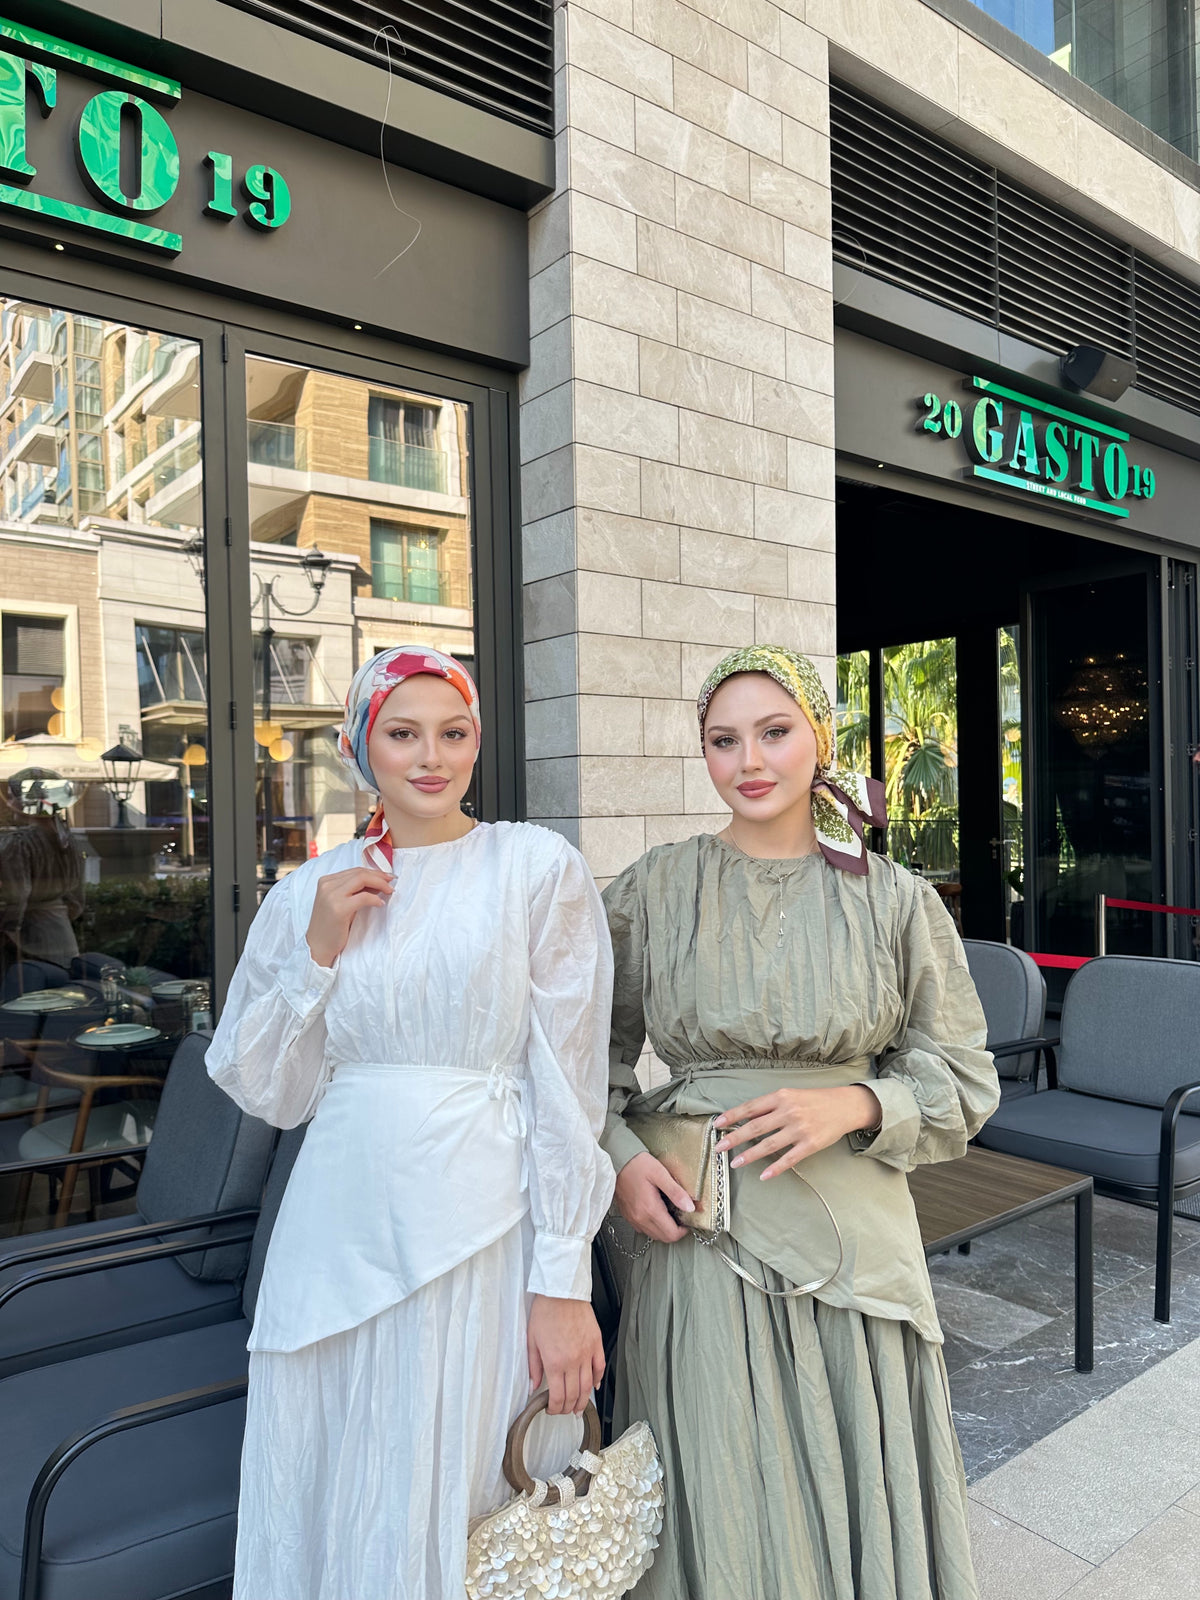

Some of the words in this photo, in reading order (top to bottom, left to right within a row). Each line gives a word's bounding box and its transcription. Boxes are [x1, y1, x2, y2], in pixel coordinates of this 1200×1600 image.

[207, 151, 291, 228] 19
[923, 392, 963, 439] 20
[972, 396, 1129, 500] GASTO
[1132, 464, 1156, 499] 19
[1046, 487, 1057, 497] AND
[1058, 490, 1073, 502] LOCAL
[1074, 495, 1087, 505] FOOD
